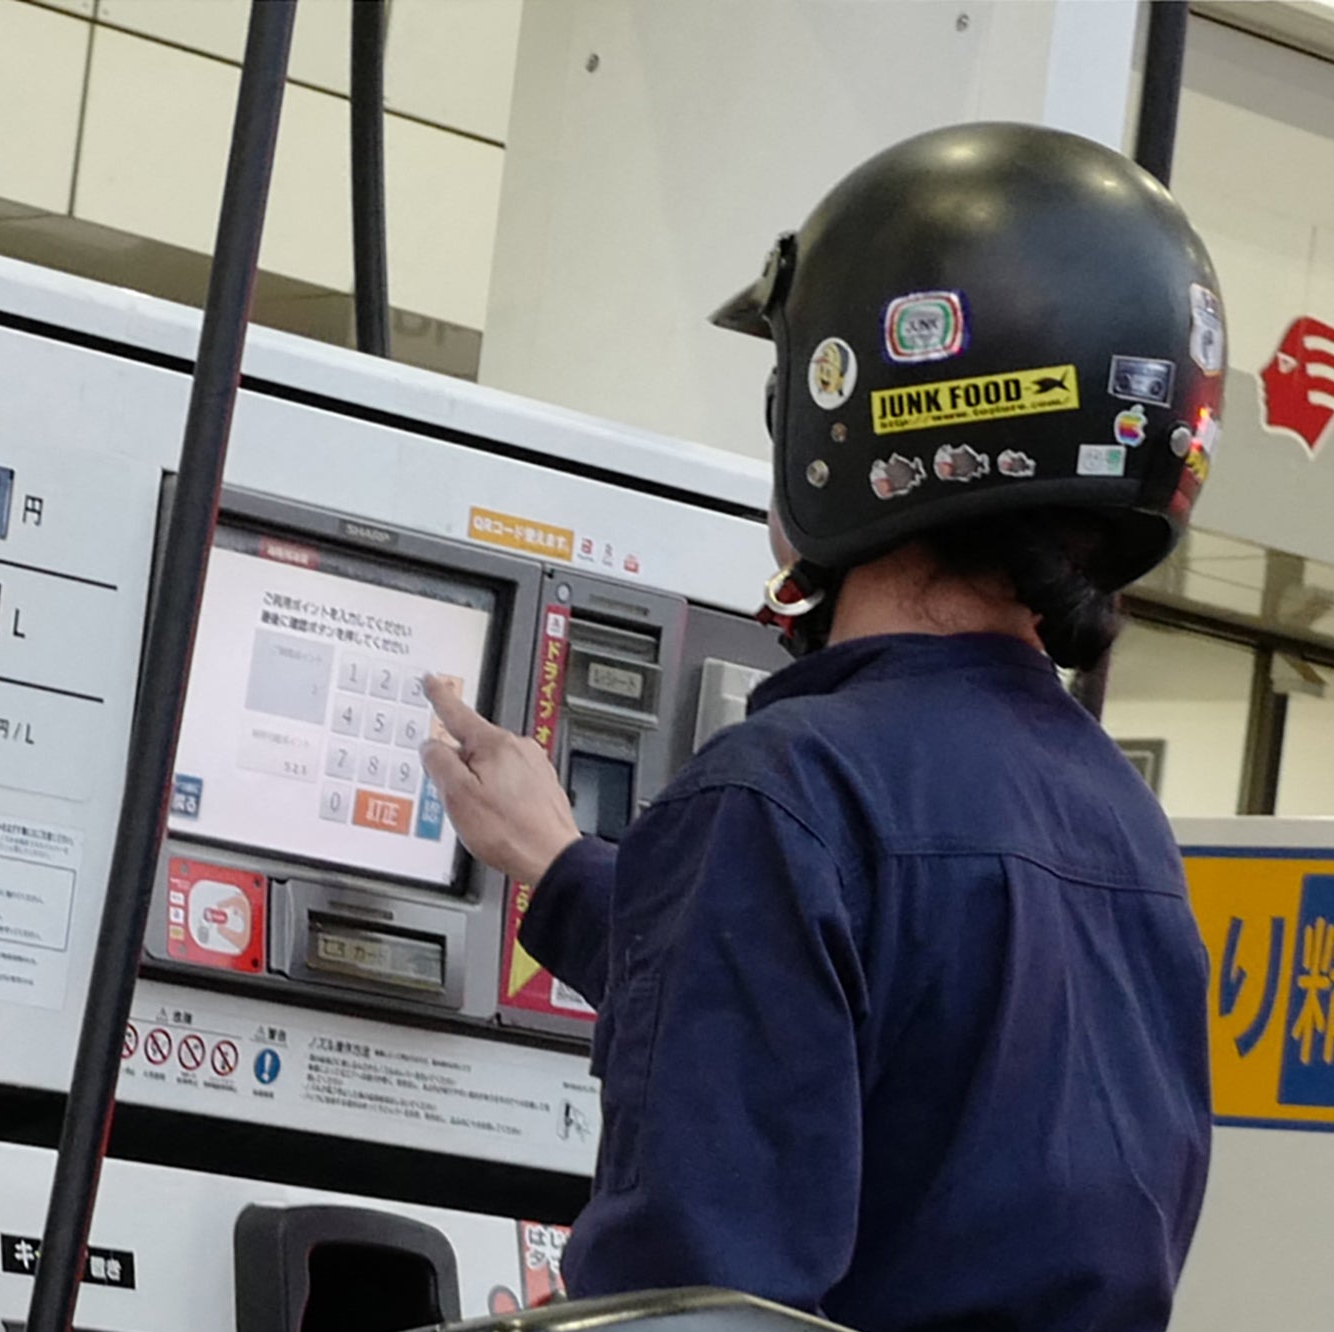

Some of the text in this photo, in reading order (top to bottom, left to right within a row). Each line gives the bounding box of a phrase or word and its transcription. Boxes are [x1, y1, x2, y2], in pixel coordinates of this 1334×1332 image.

[878, 378, 1022, 420] JUNK FOOD
[21, 493, 45, 527] 円
[11, 607, 26, 639] L
[348, 662, 358, 683] 1
[379, 668, 392, 690] 2
[341, 706, 417, 739] 4 5 6
[334, 748, 412, 783] 7 8 9
[329, 791, 342, 812] 0
[365, 796, 401, 827] 訂正
